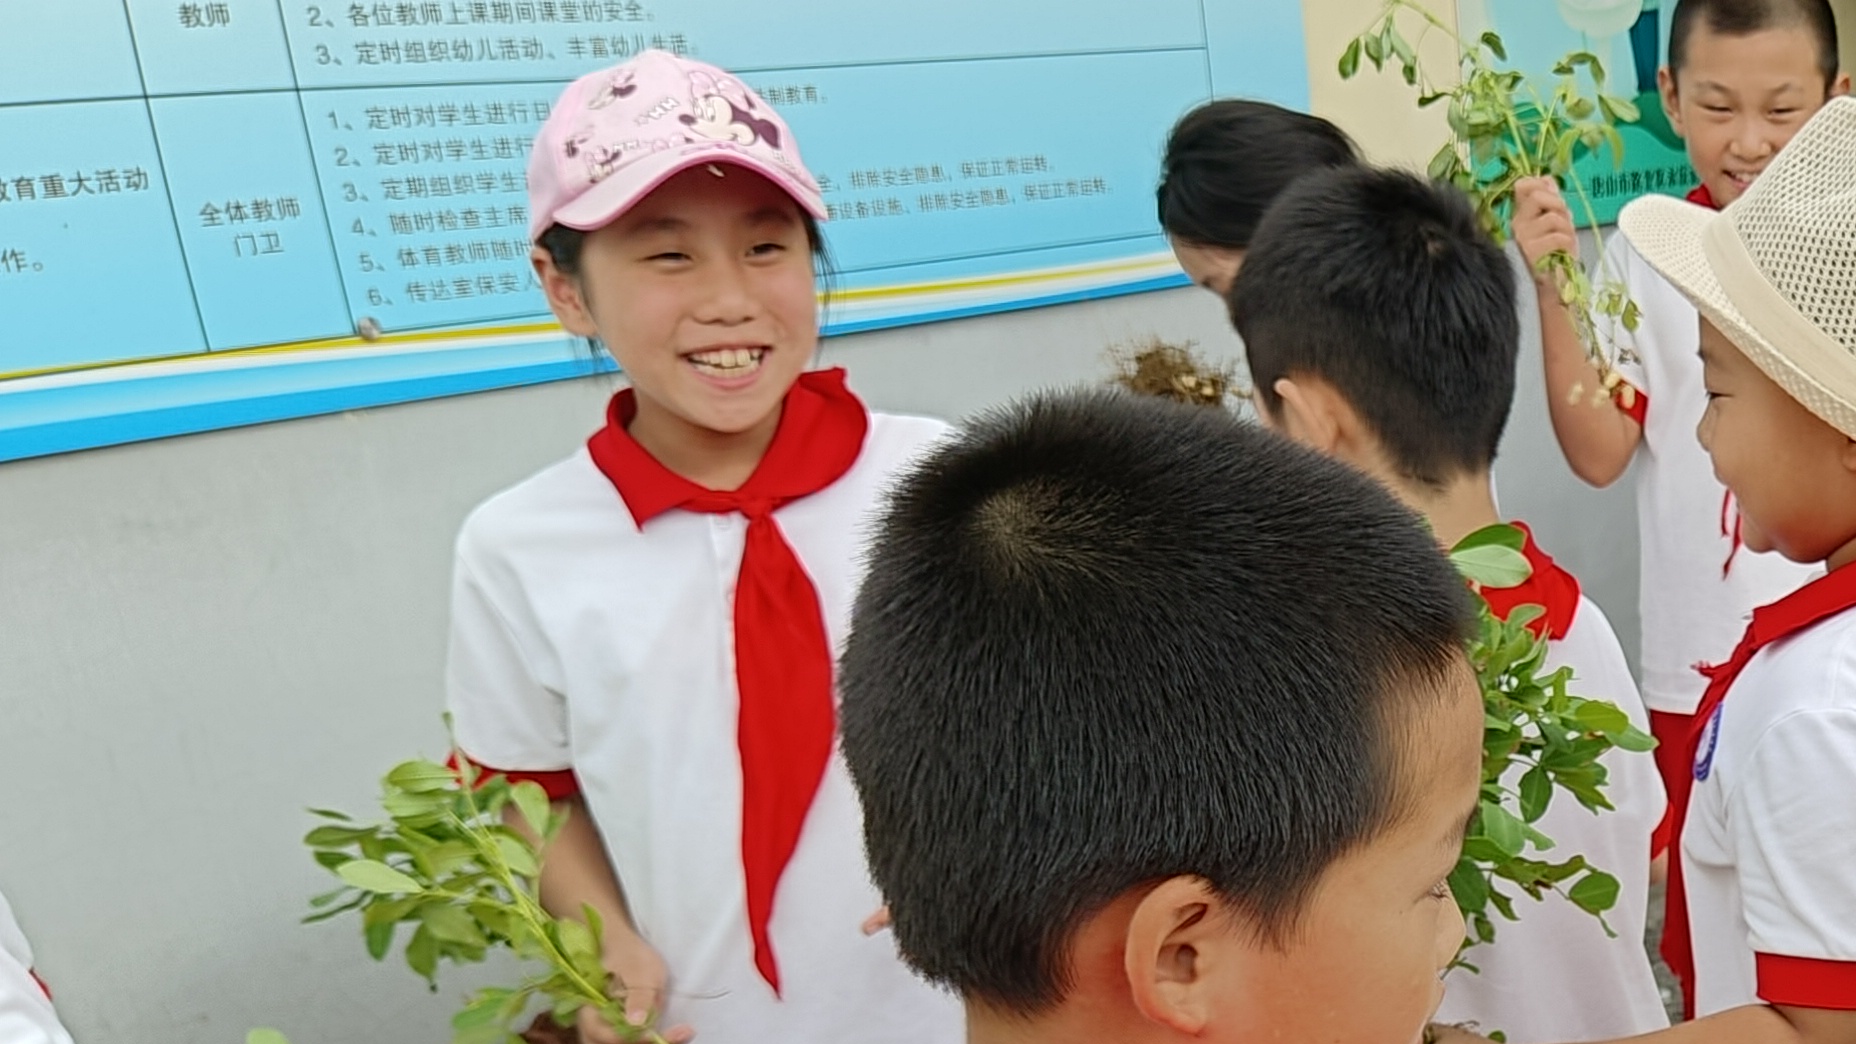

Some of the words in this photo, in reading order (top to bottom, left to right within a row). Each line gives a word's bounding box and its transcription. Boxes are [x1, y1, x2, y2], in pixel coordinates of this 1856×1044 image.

[178, 1, 231, 28] 教师
[342, 171, 531, 203] 3、定期组织学生
[198, 197, 301, 228] 全体教师
[233, 232, 285, 257] 门卫
[0, 247, 44, 273] 作。
